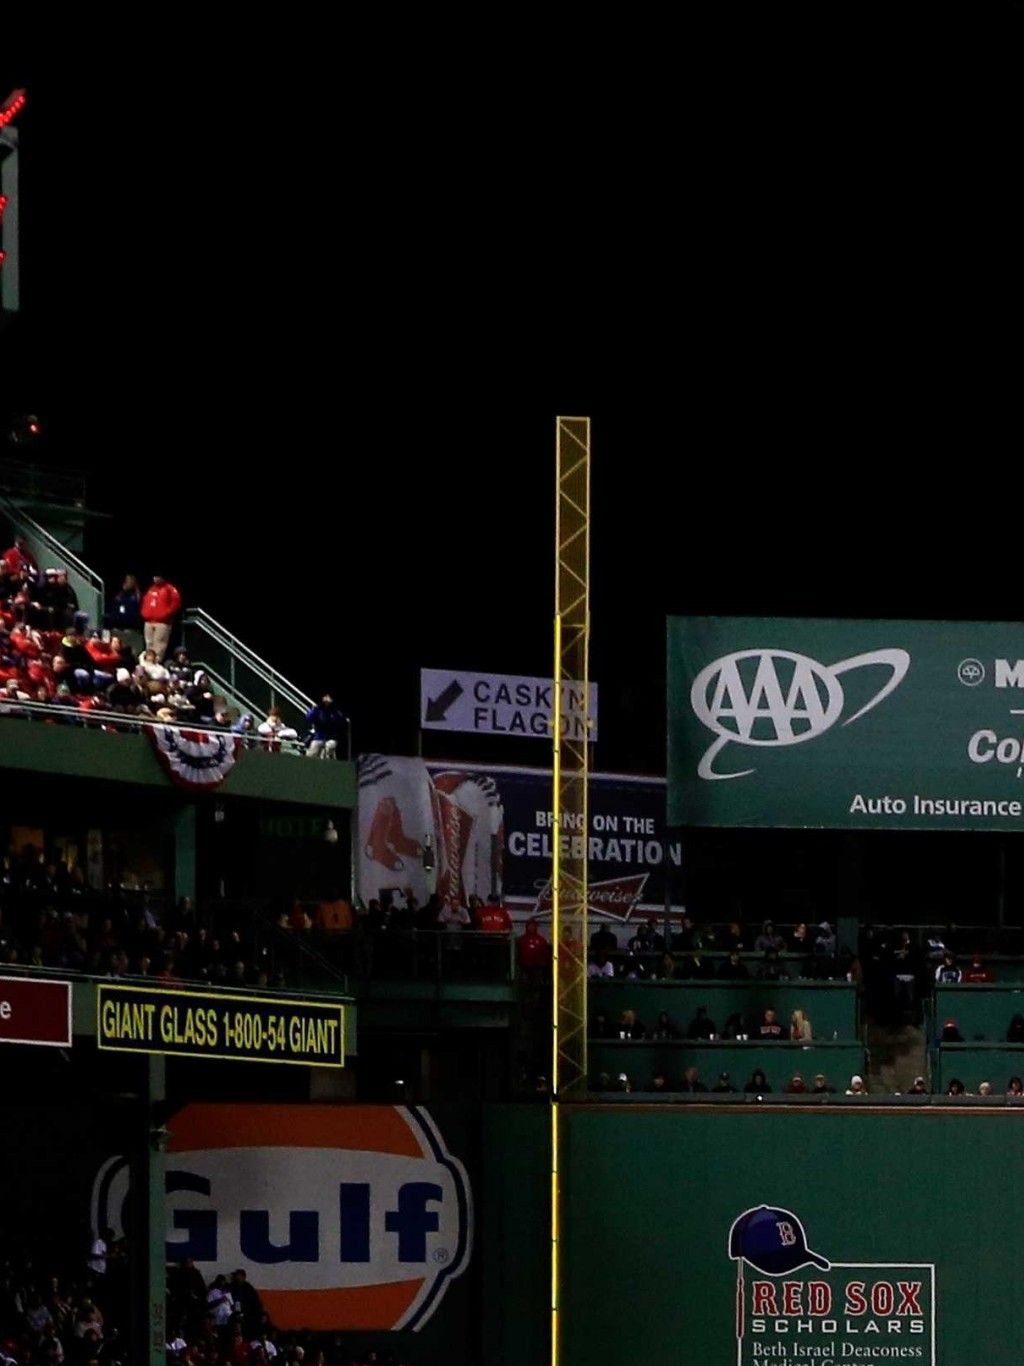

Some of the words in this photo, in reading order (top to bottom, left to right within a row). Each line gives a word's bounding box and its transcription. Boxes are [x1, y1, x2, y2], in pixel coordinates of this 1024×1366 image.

[706, 655, 829, 742] AAA
[474, 707, 590, 738] FLAGON
[850, 793, 908, 815] Auto
[913, 795, 1022, 817] Insurance
[592, 815, 618, 831] ON
[623, 816, 655, 835] THE
[508, 831, 682, 866] CELEBRATION
[103, 1001, 155, 1040] GIANT
[160, 1005, 217, 1046] GLASS
[223, 1011, 285, 1051] 1-800-54
[289, 1016, 338, 1055] GIANT
[124, 1170, 443, 1264] Gulf
[752, 1281, 832, 1316] RED
[845, 1281, 923, 1316] SOX
[752, 1319, 924, 1333] SCHOLARS
[753, 1342, 787, 1357] Beth
[793, 1342, 835, 1357] Israel
[841, 1342, 922, 1357] Deaconess
